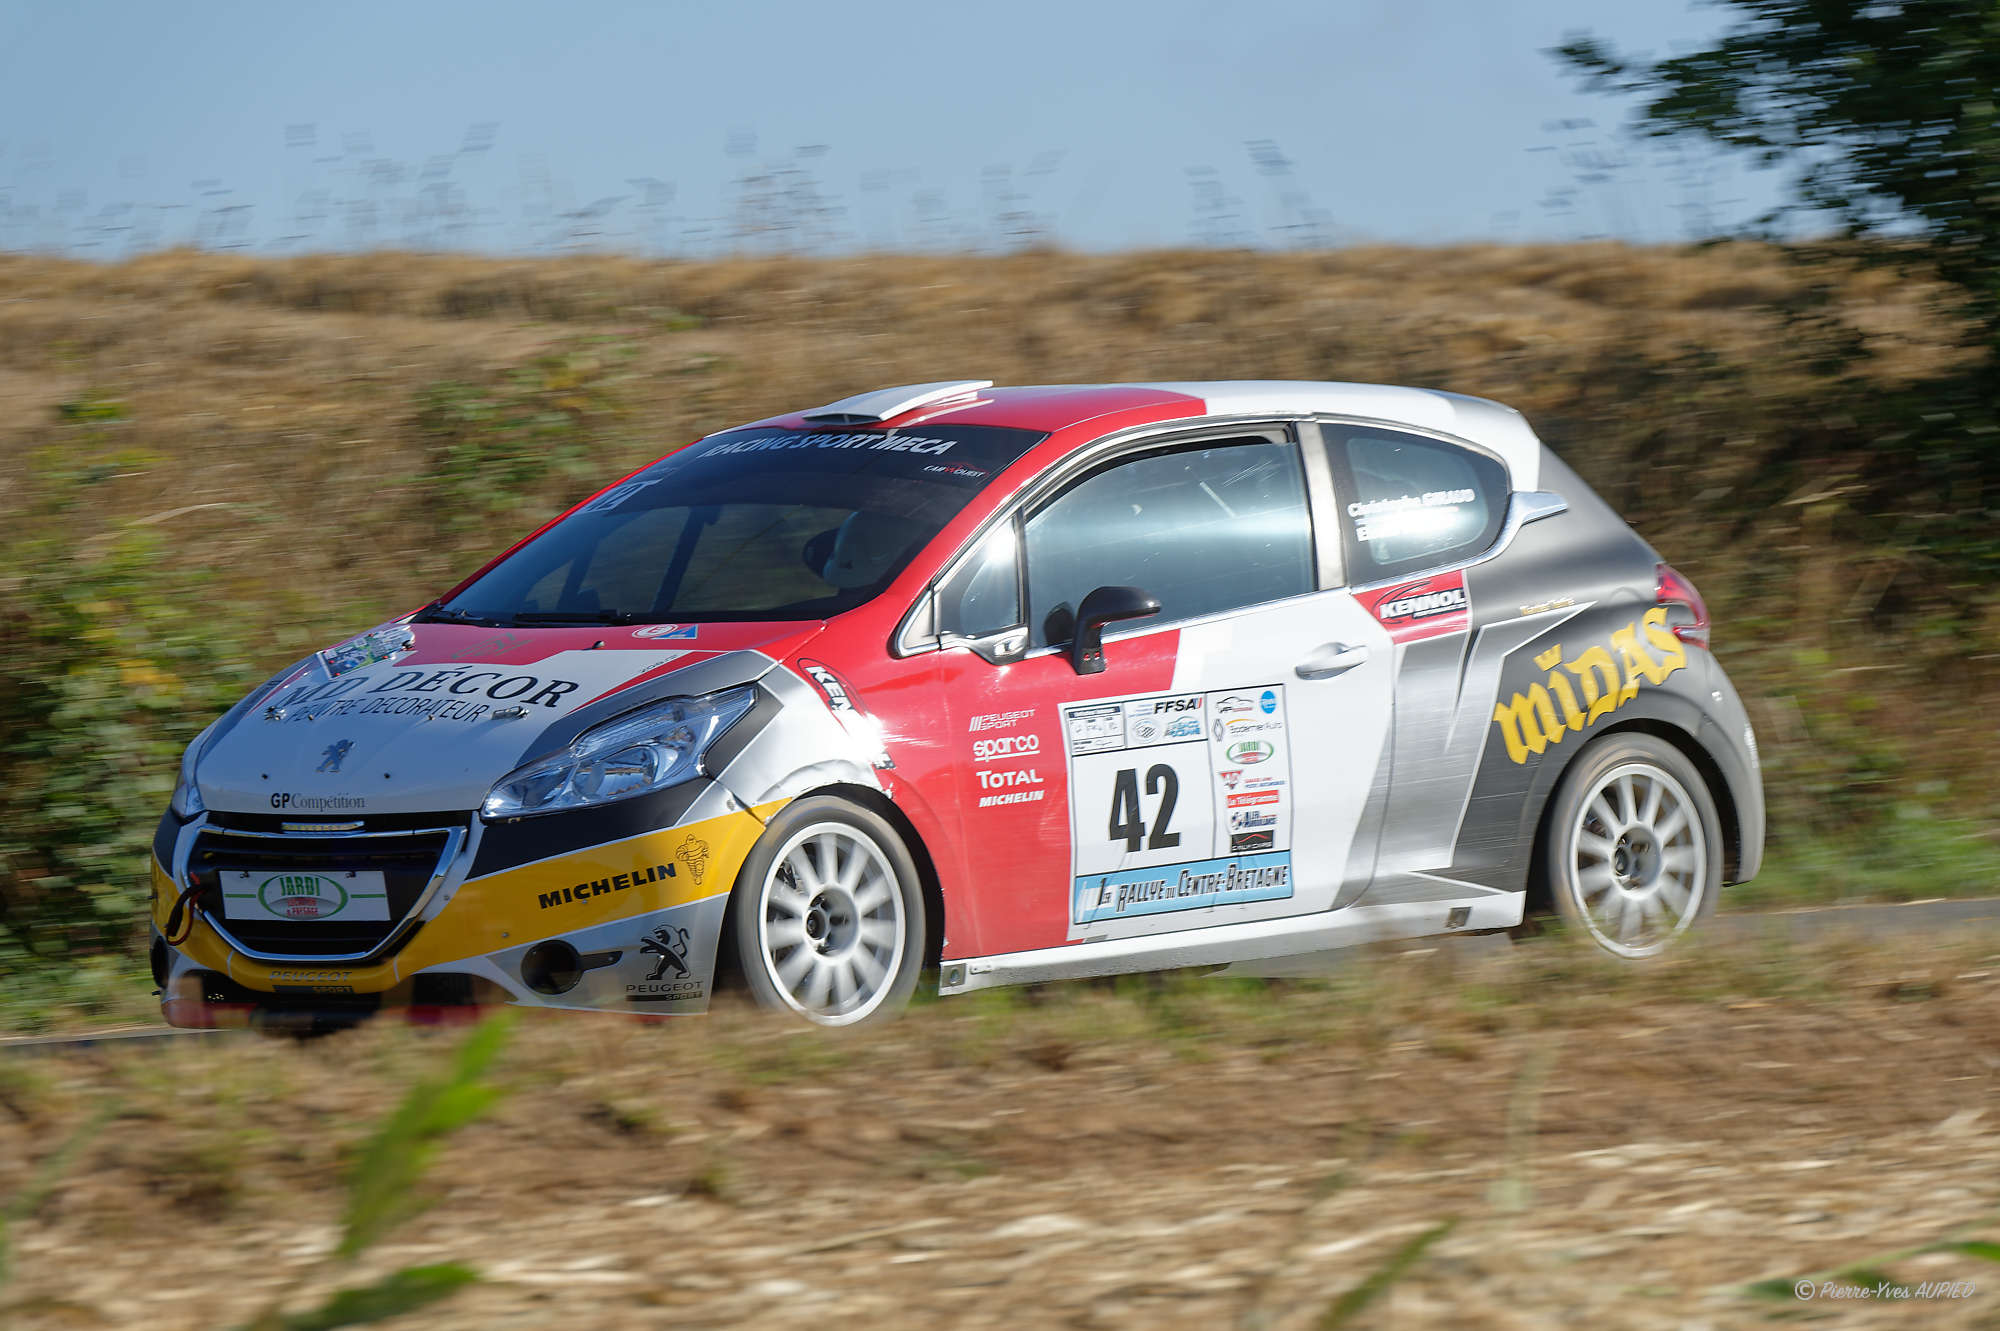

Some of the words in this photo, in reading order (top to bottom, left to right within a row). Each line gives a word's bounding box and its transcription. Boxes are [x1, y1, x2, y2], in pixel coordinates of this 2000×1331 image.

[797, 433, 880, 451] SPORT
[874, 434, 957, 456] MECA
[1379, 588, 1466, 620] KENNOL
[367, 665, 579, 708] DÉCOR
[982, 709, 1036, 722] PEUGEOT
[1153, 698, 1197, 715] FFSA
[972, 734, 1040, 762] sparco
[976, 768, 1044, 789] TOTAL
[979, 790, 1045, 807] MICHELIN
[1109, 763, 1180, 852] 42
[279, 876, 320, 897] JARDI
[538, 862, 677, 909] MICHELIN
[1115, 879, 1166, 912] RALLYE
[1177, 862, 1289, 898] CENTRE-BRETAGNE
[268, 969, 353, 983] PEUGEOT
[625, 981, 704, 994] PEUGEOT
